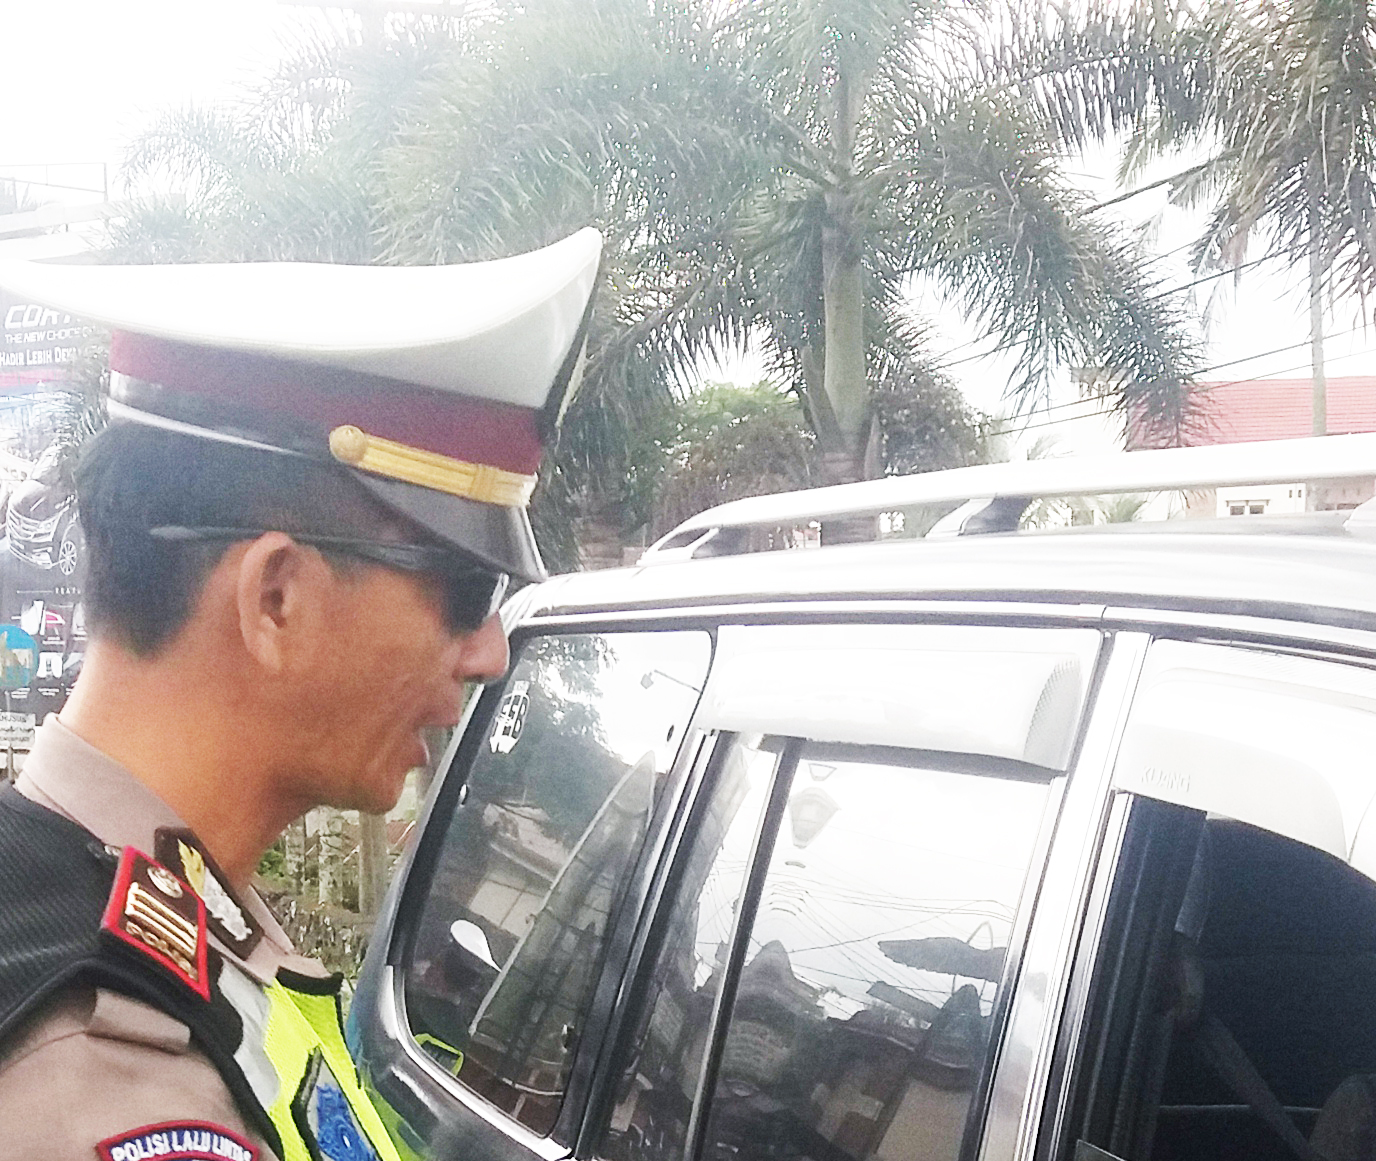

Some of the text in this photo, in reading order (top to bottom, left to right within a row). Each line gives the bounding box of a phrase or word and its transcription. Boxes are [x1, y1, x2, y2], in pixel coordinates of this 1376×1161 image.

[4, 332, 23, 343] THE
[24, 330, 46, 343] NEW
[26, 349, 52, 365] LEBIH
[171, 1130, 212, 1152] LALU
